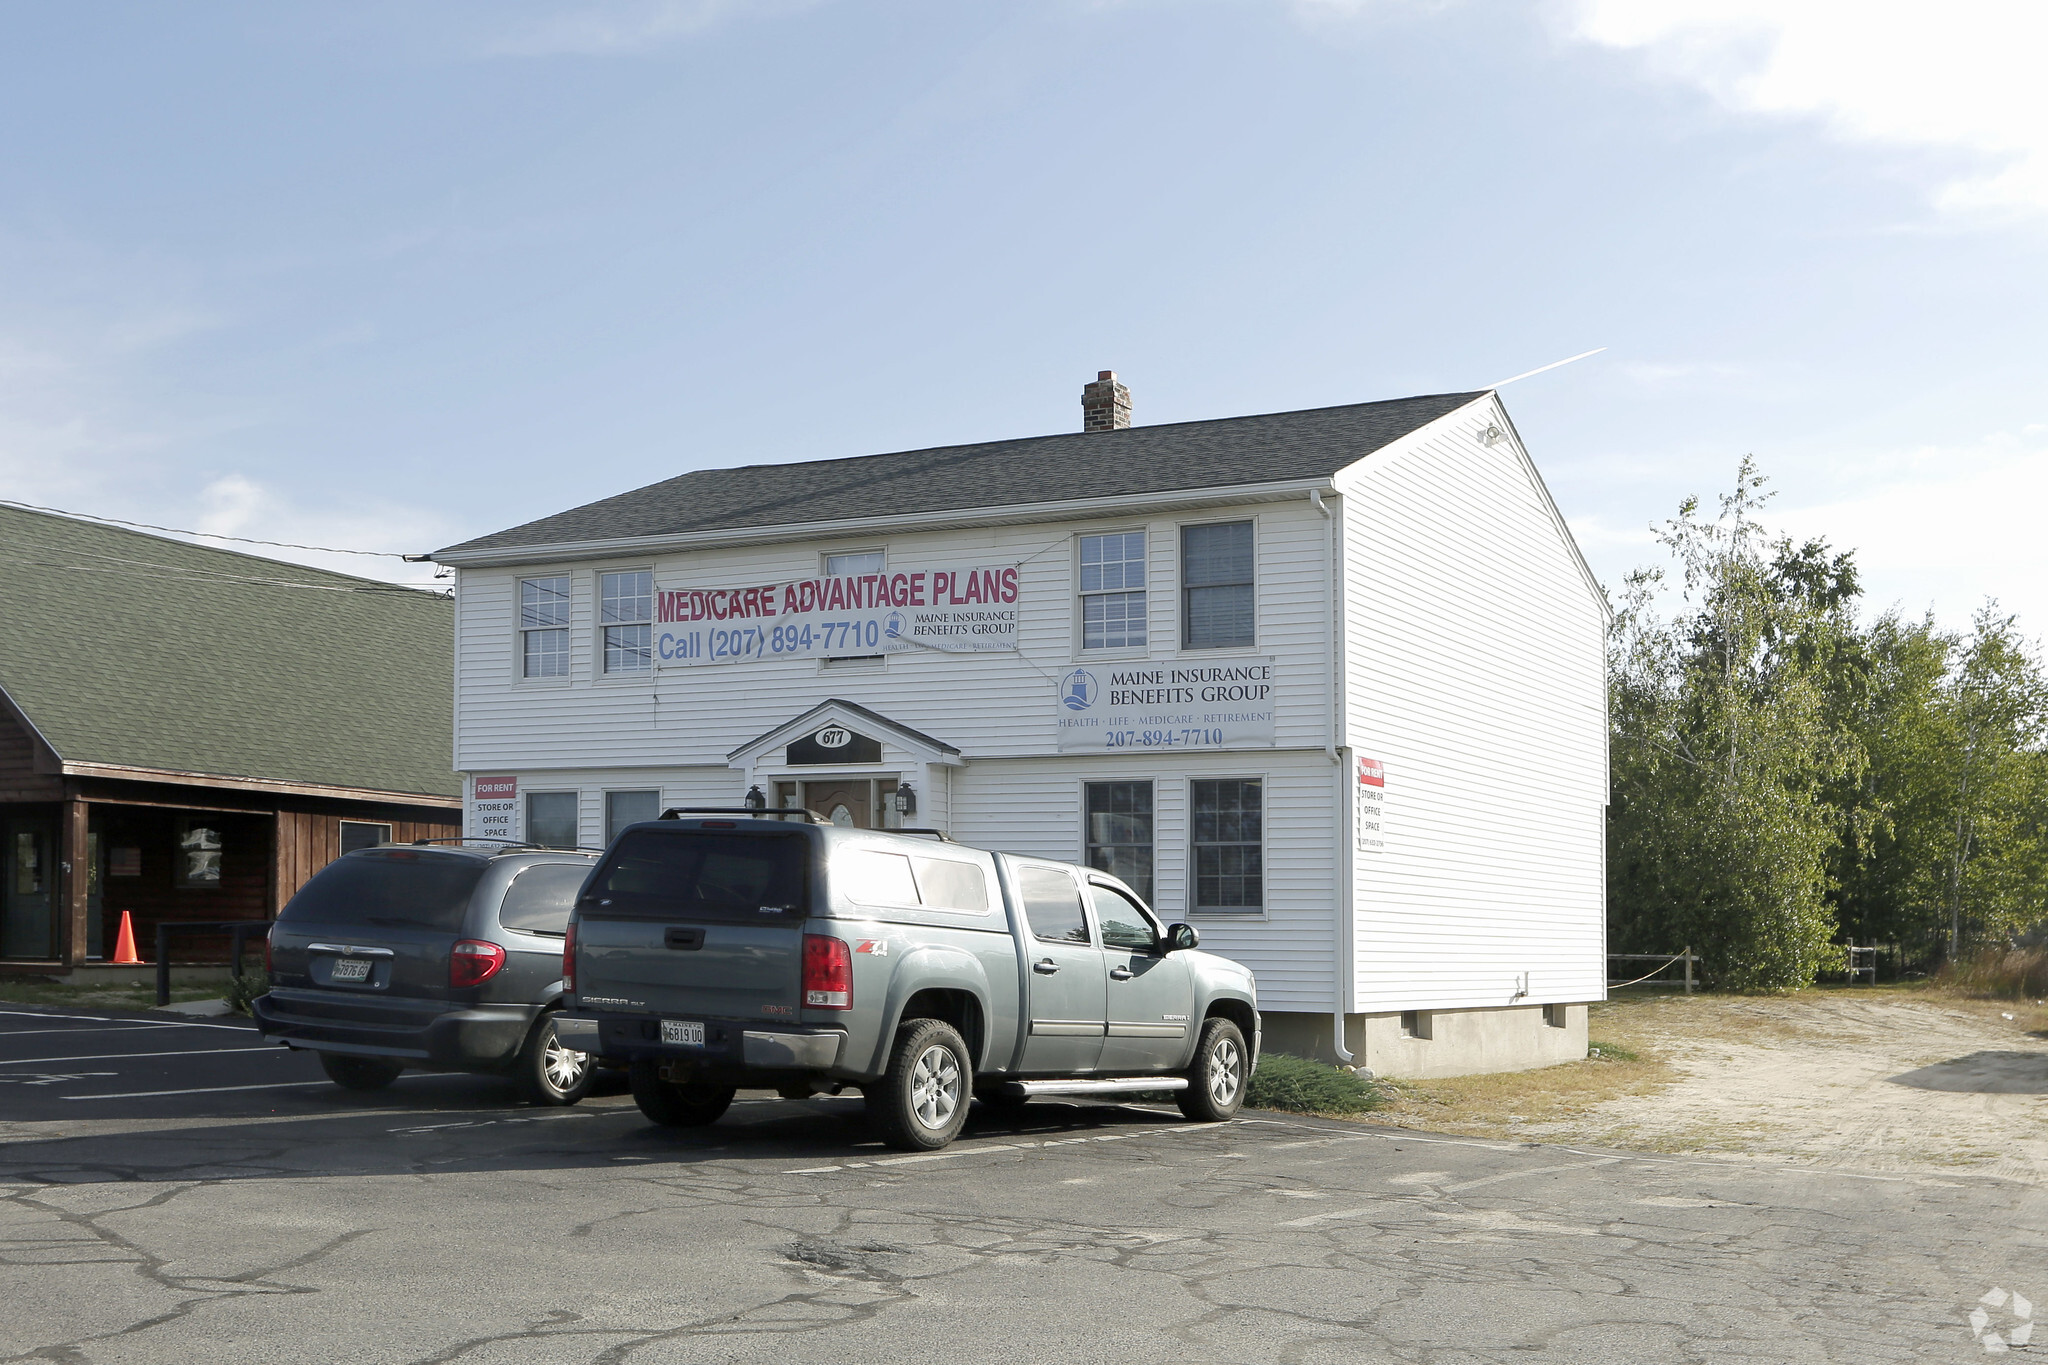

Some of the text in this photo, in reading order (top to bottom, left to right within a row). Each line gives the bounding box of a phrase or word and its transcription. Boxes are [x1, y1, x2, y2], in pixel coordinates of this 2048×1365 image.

[658, 568, 1018, 623] MEDICARE ADVANTAGE PLANS
[915, 611, 1015, 623] MAINE INSURANCE
[914, 623, 1015, 636] BENEFITS GROUP
[658, 620, 879, 661] Call (207) 894-7710
[1110, 665, 1271, 686] MAINE INSURANCE
[1110, 684, 1270, 706] BENEFITS GROUP
[1058, 711, 1272, 728] HEALTH LIFE MEDICARE RETIREMENT
[823, 730, 845, 745] 677
[1105, 727, 1223, 747] 207-894-7710
[478, 783, 513, 792] FOR RENT
[1362, 790, 1383, 801] STORE OR
[478, 803, 514, 811] STORE OR
[1364, 805, 1381, 816] OFFICE
[1365, 821, 1379, 831] SPACE
[339, 964, 358, 976] 7876
[582, 996, 629, 1005] SIERRA
[761, 1005, 793, 1015] GMC
[669, 1027, 690, 1042] 6819
